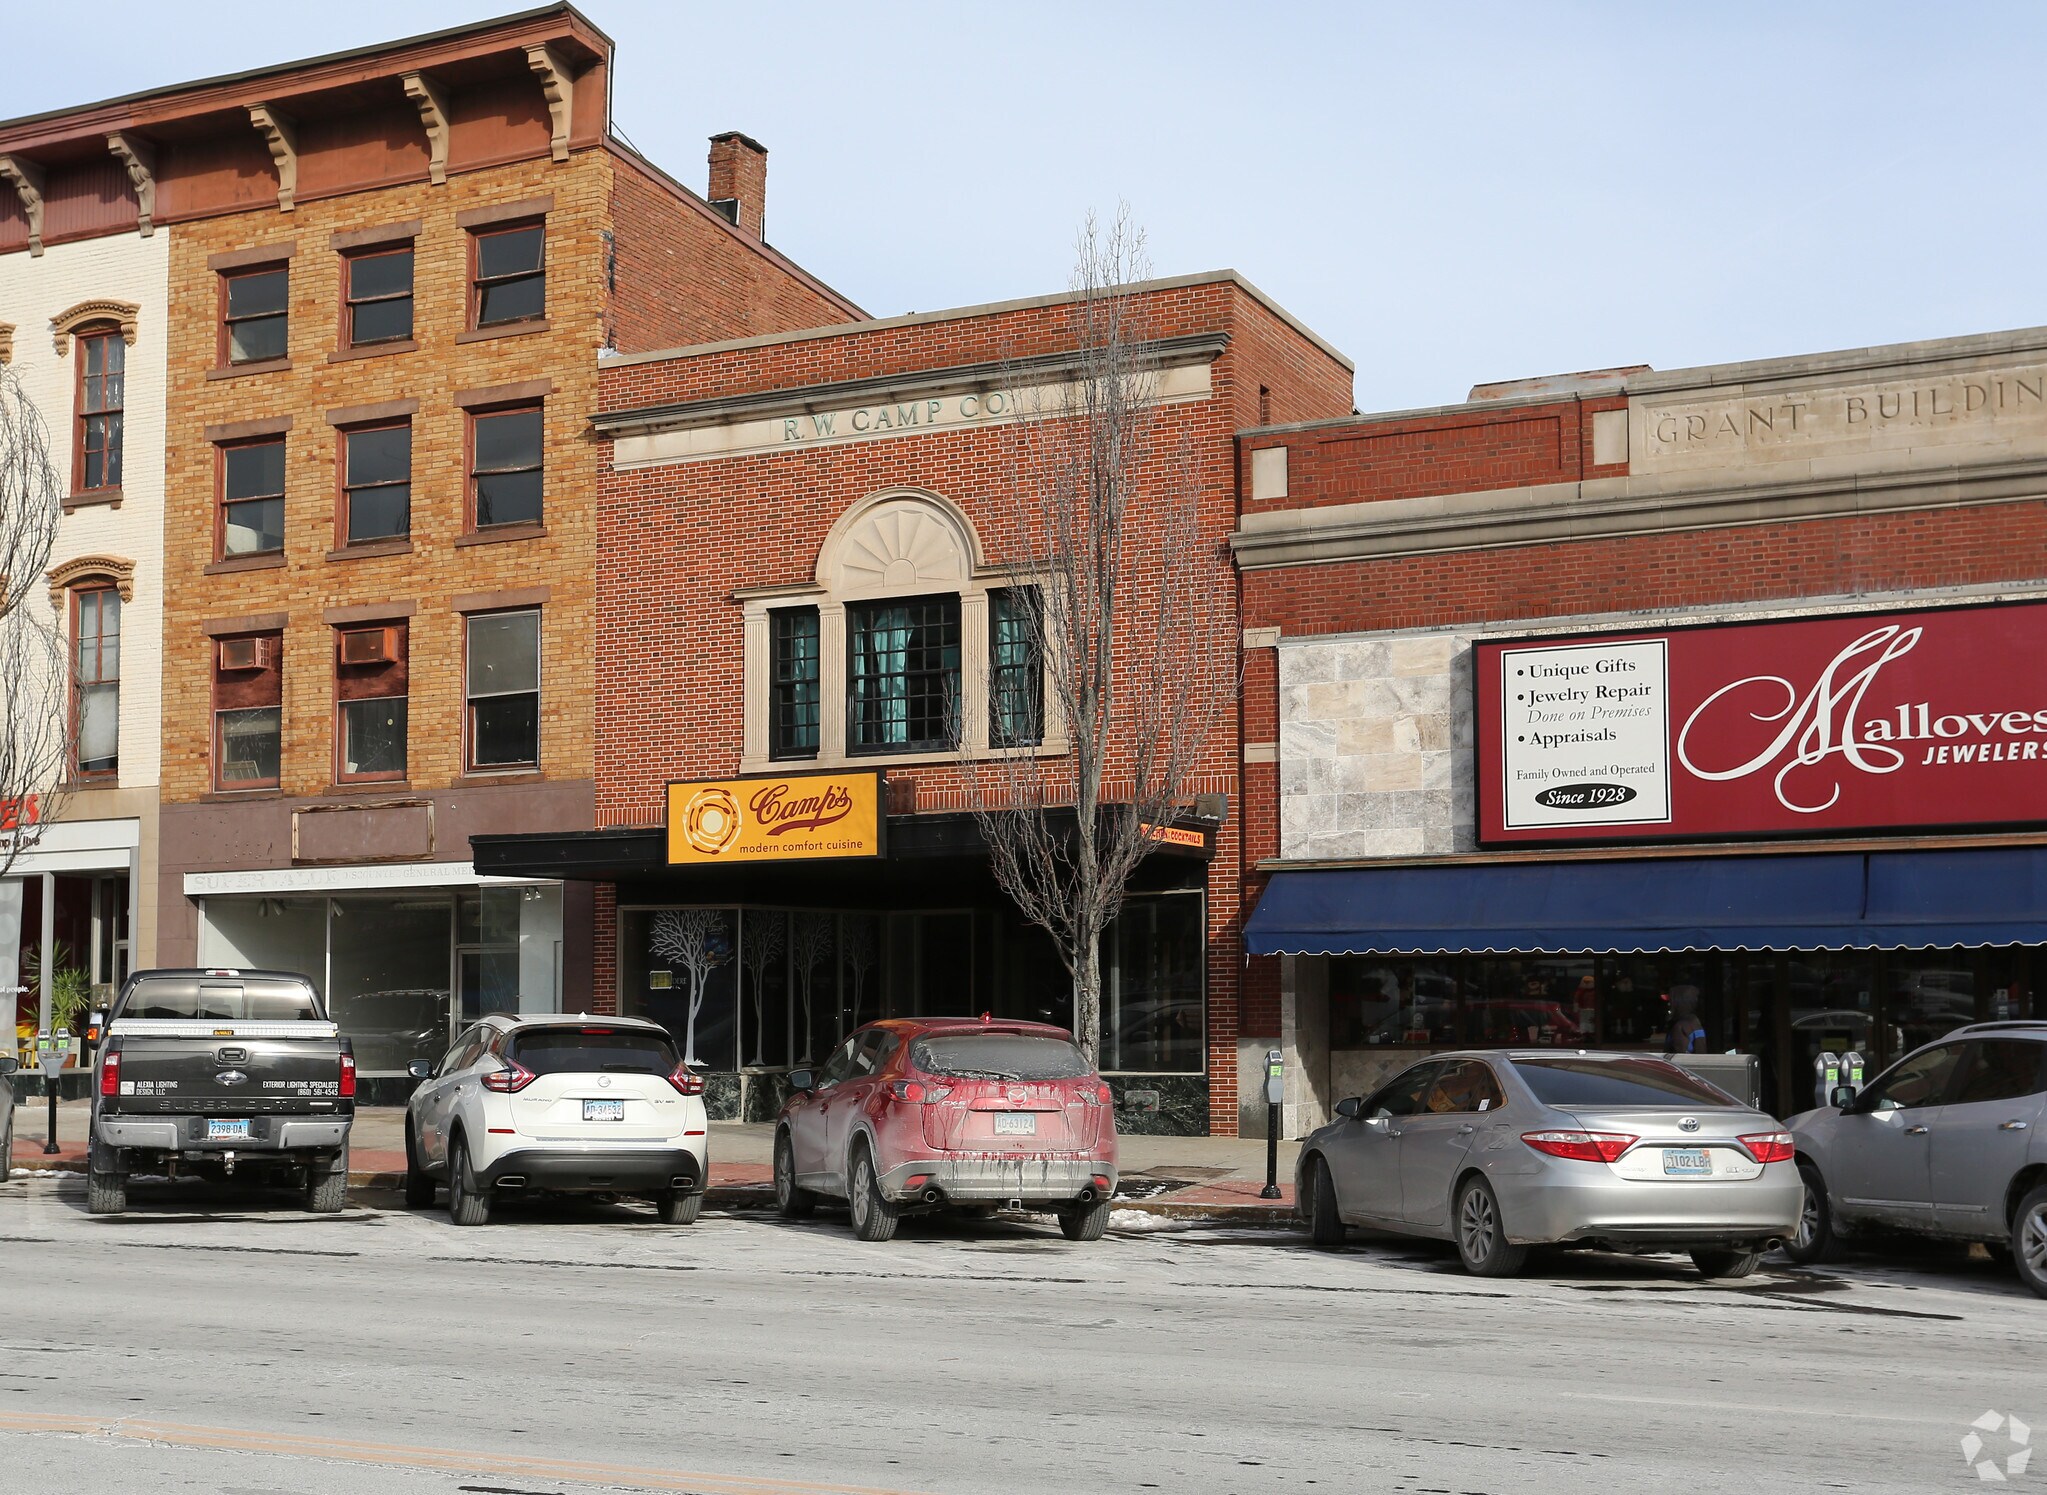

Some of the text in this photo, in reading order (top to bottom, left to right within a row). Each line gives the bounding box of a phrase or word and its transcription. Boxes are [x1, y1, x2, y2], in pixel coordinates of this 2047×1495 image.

[783, 419, 806, 441] R.
[852, 399, 943, 431] CAMP
[960, 393, 1011, 418] CO.
[1655, 403, 1807, 443] GRANT
[1528, 658, 1637, 681] Unique Gifts
[1528, 682, 1652, 708] Jewelry Repair
[1527, 704, 1652, 724] Done on Premises
[1529, 727, 1617, 749] Appraisals
[1516, 763, 1656, 782] Family Owned and Operated
[1546, 786, 1627, 806] Since 1928
[750, 784, 853, 835] Camp's
[740, 840, 864, 853] modern comfort cuisine
[136, 1081, 155, 1089] ALEXIA
[155, 1081, 179, 1089] LIGHTING
[156, 1088, 166, 1096] LLC
[262, 1081, 339, 1089] EXTERIOR LIGHTING SPECIALISTS
